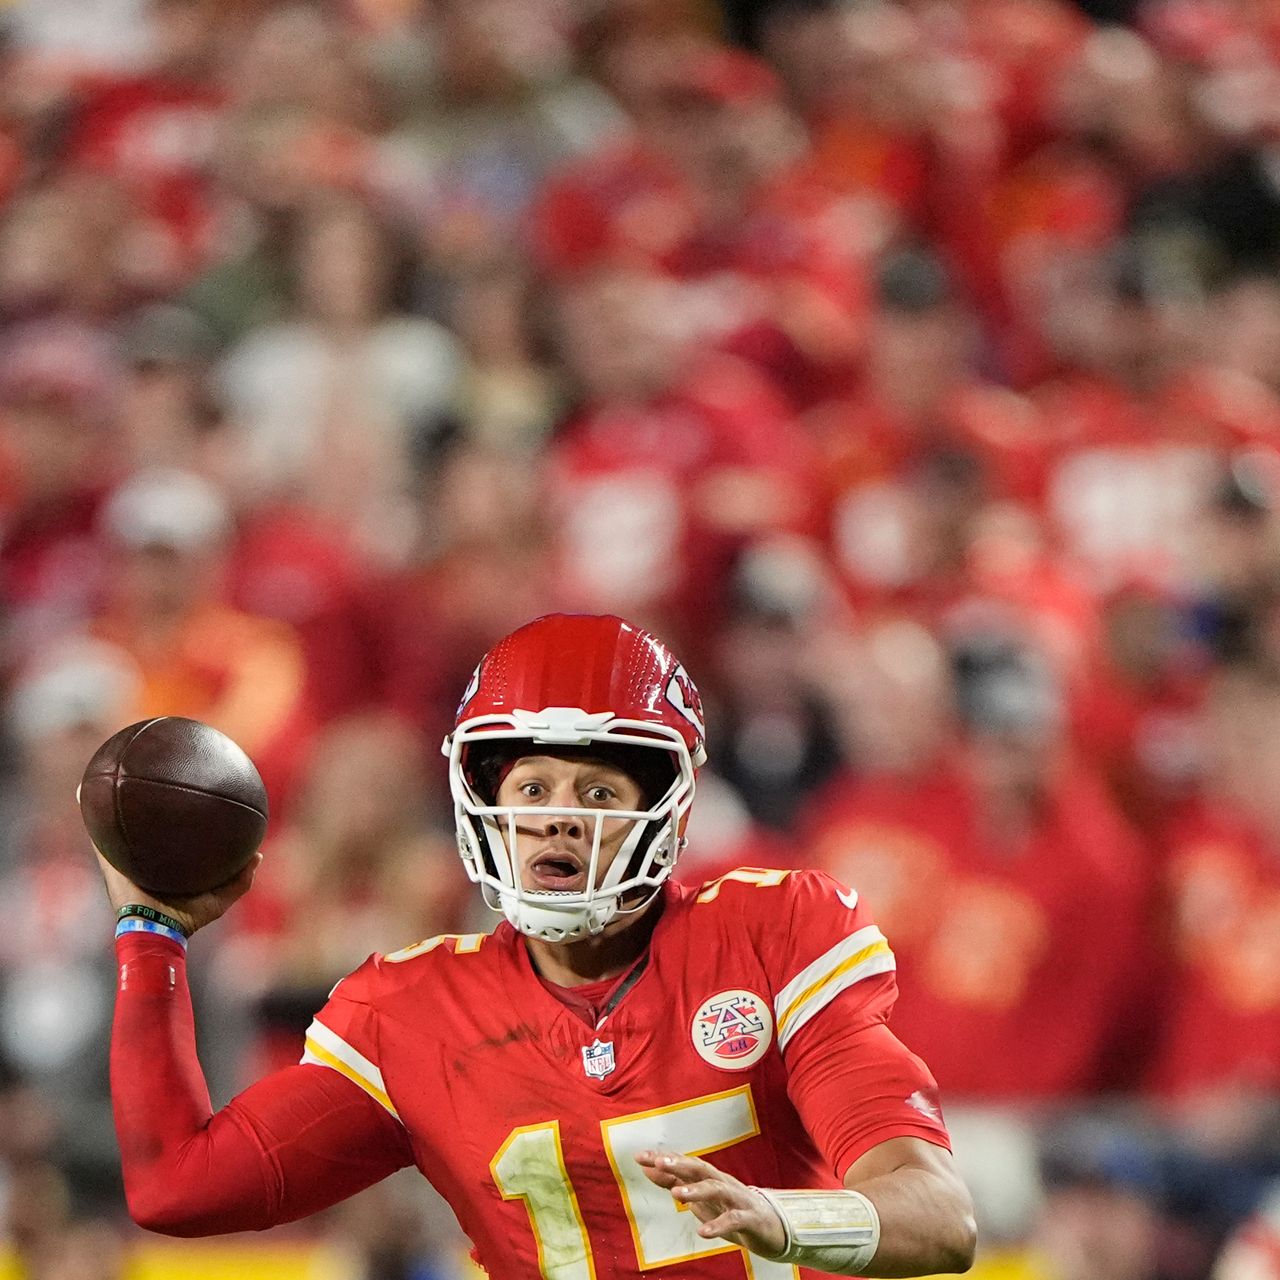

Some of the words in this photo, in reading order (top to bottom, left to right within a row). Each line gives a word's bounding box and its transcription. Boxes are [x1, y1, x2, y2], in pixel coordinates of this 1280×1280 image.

[136, 906, 156, 919] FOR
[703, 997, 764, 1046] A
[588, 1055, 612, 1074] NFL
